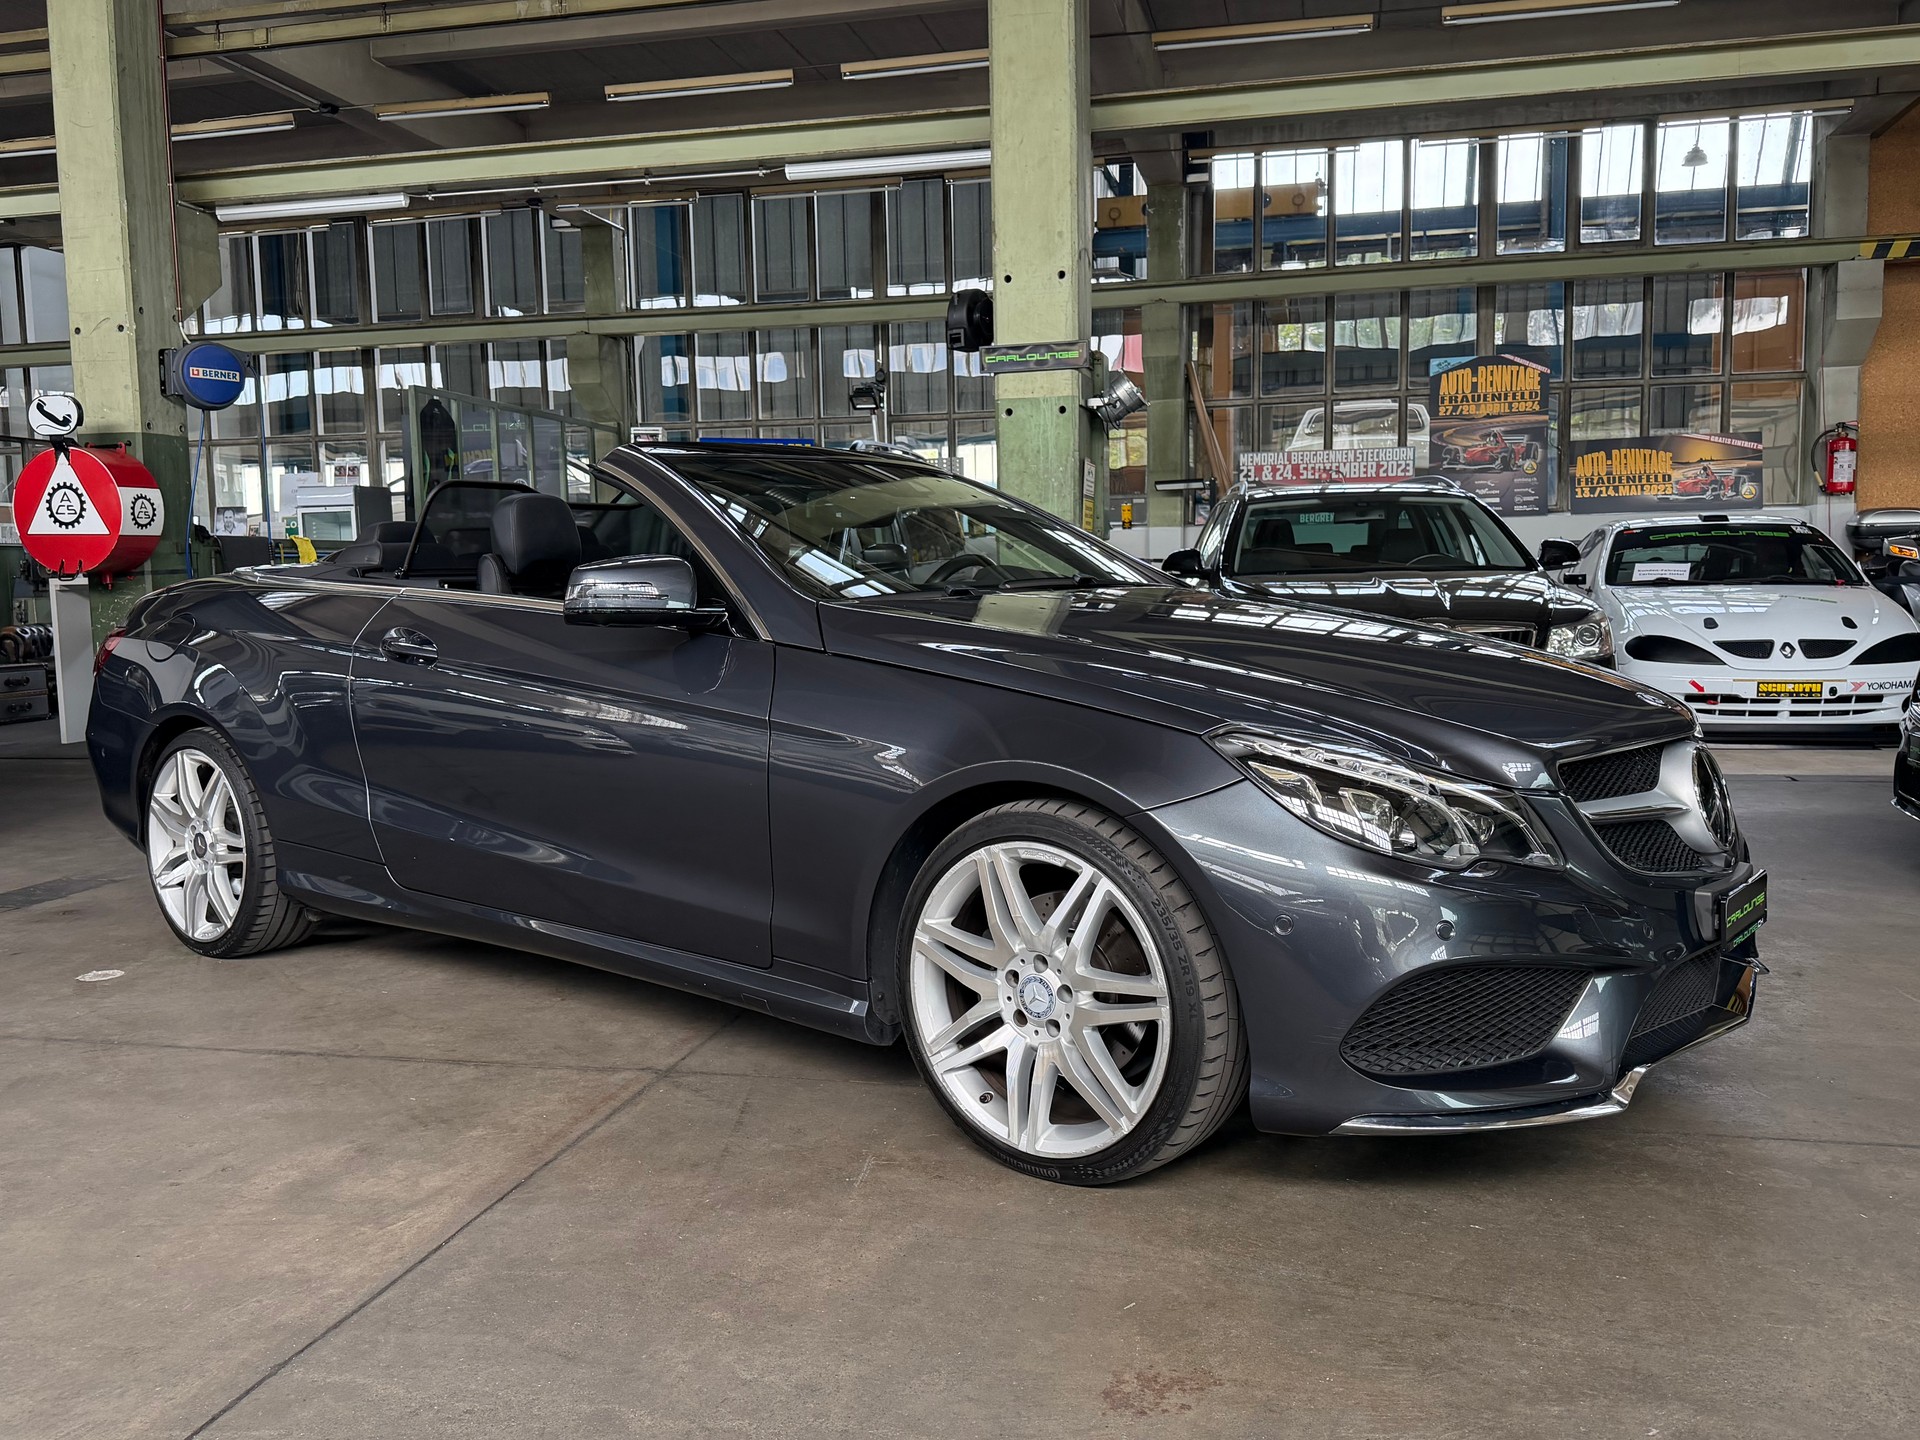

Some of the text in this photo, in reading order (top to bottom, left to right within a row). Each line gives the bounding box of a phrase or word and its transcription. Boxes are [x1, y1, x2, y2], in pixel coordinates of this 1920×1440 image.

[985, 351, 1080, 364] CARLOUNGE
[202, 369, 238, 382] BERNER
[1439, 365, 1541, 395] AUTO-RENNTAGE
[1439, 390, 1541, 406] FRAUENFELD
[1512, 401, 1540, 412] 2024
[1710, 435, 1759, 449] GRATIS EINTRITT
[1239, 447, 1415, 466] MEMORIAL BERGRENNEN STECKBORN
[1575, 448, 1673, 478] AUTO-RENNTAGE
[1239, 466, 1259, 482] 23.
[1262, 465, 1273, 481] &
[1276, 464, 1297, 481] 24.
[1379, 460, 1414, 478] 2023
[1575, 473, 1673, 488] FRAUENFELD
[1643, 484, 1673, 496] 2023
[1649, 529, 1791, 541] CARLOUNGE
[1758, 683, 1822, 693] SCHROTH
[1726, 891, 1766, 929] CARLOUNGE
[1151, 898, 1198, 1022] 235/35 ZR 19 XL
